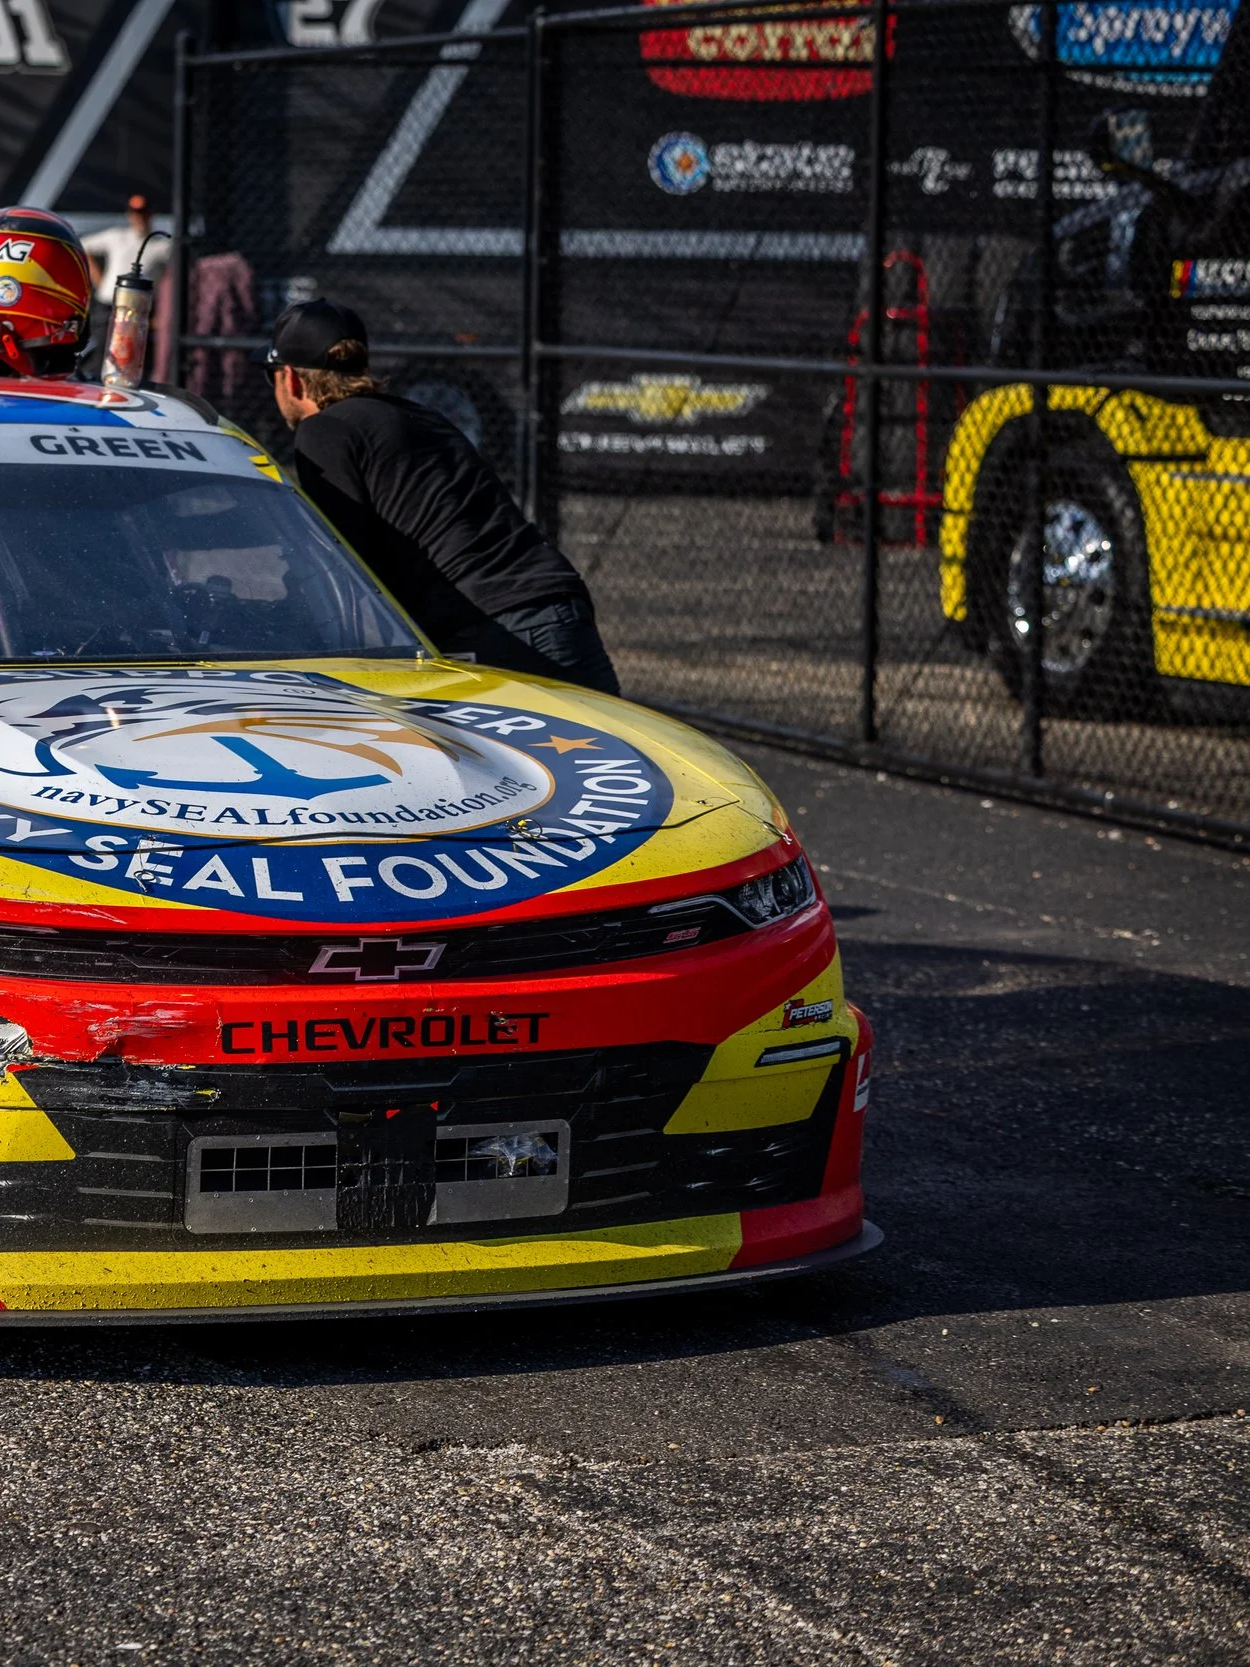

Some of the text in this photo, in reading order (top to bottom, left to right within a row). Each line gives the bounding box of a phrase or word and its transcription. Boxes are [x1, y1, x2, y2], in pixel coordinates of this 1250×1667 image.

[30, 434, 208, 462] GREEN
[31, 774, 538, 826] navySEALfoundation.org
[67, 834, 304, 903] SEAL
[321, 758, 653, 903] FOUNDATION
[789, 1002, 834, 1020] PETERSON
[222, 1012, 550, 1055] CHEVROLET
